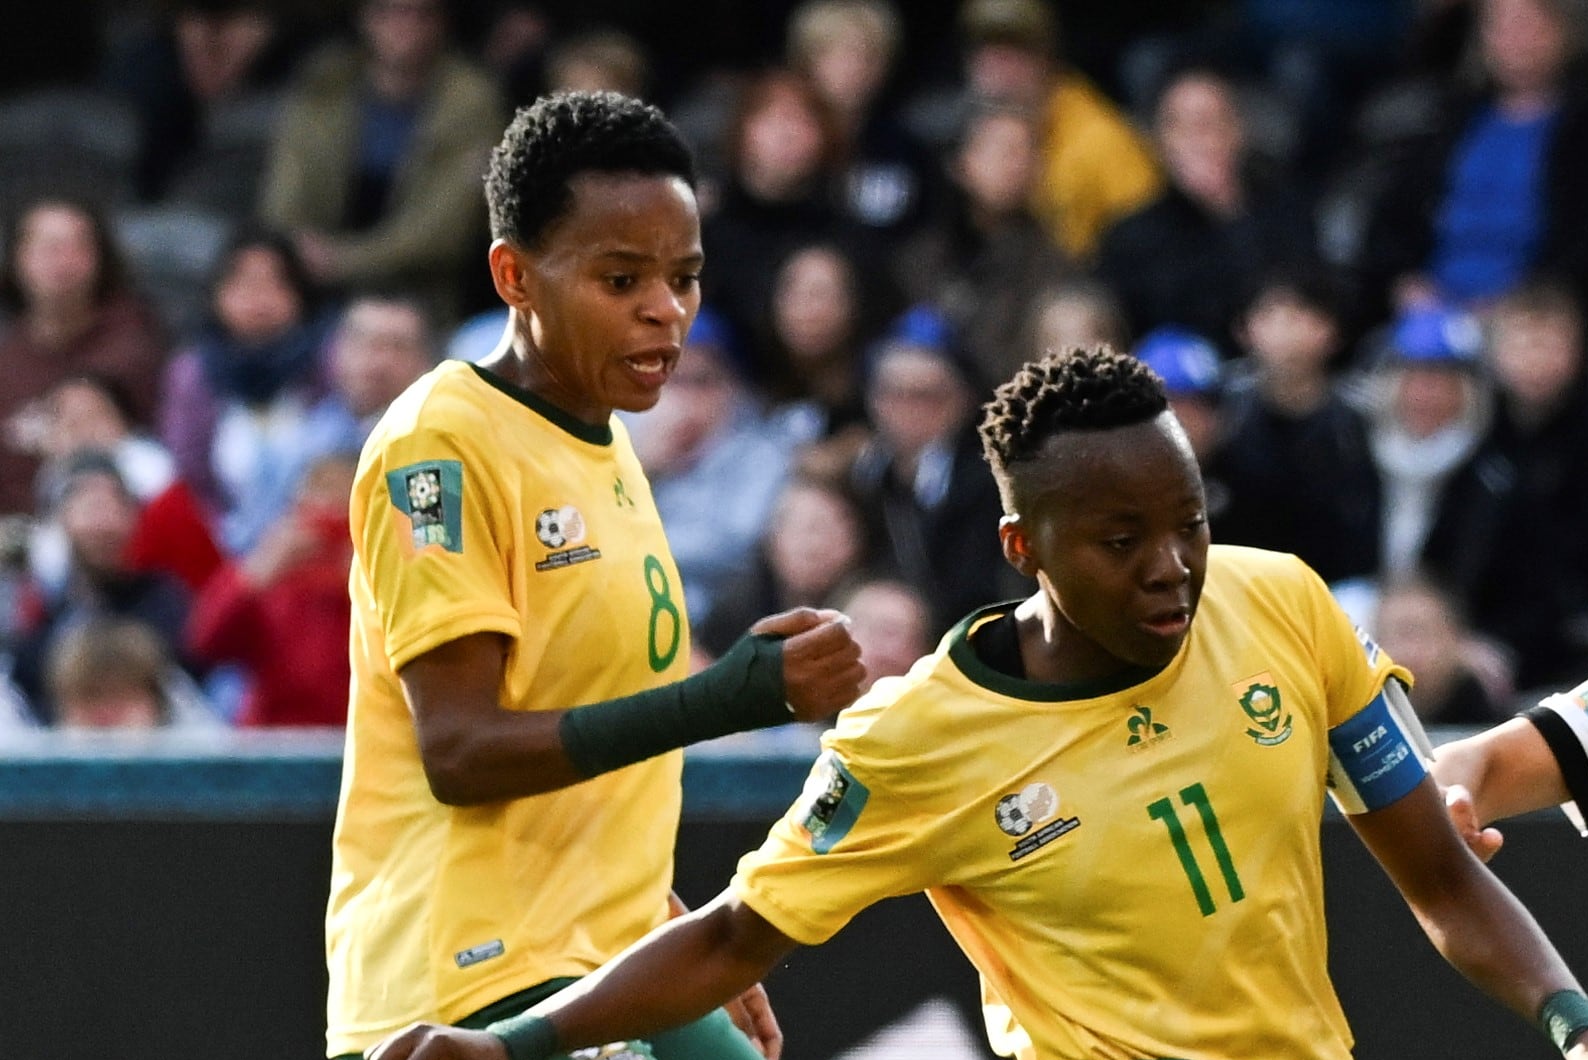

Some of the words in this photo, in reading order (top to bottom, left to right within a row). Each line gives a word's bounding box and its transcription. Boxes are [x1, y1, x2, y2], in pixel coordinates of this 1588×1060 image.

[644, 554, 680, 673] 8
[1353, 725, 1387, 753] FIFA
[1146, 782, 1246, 917] 11
